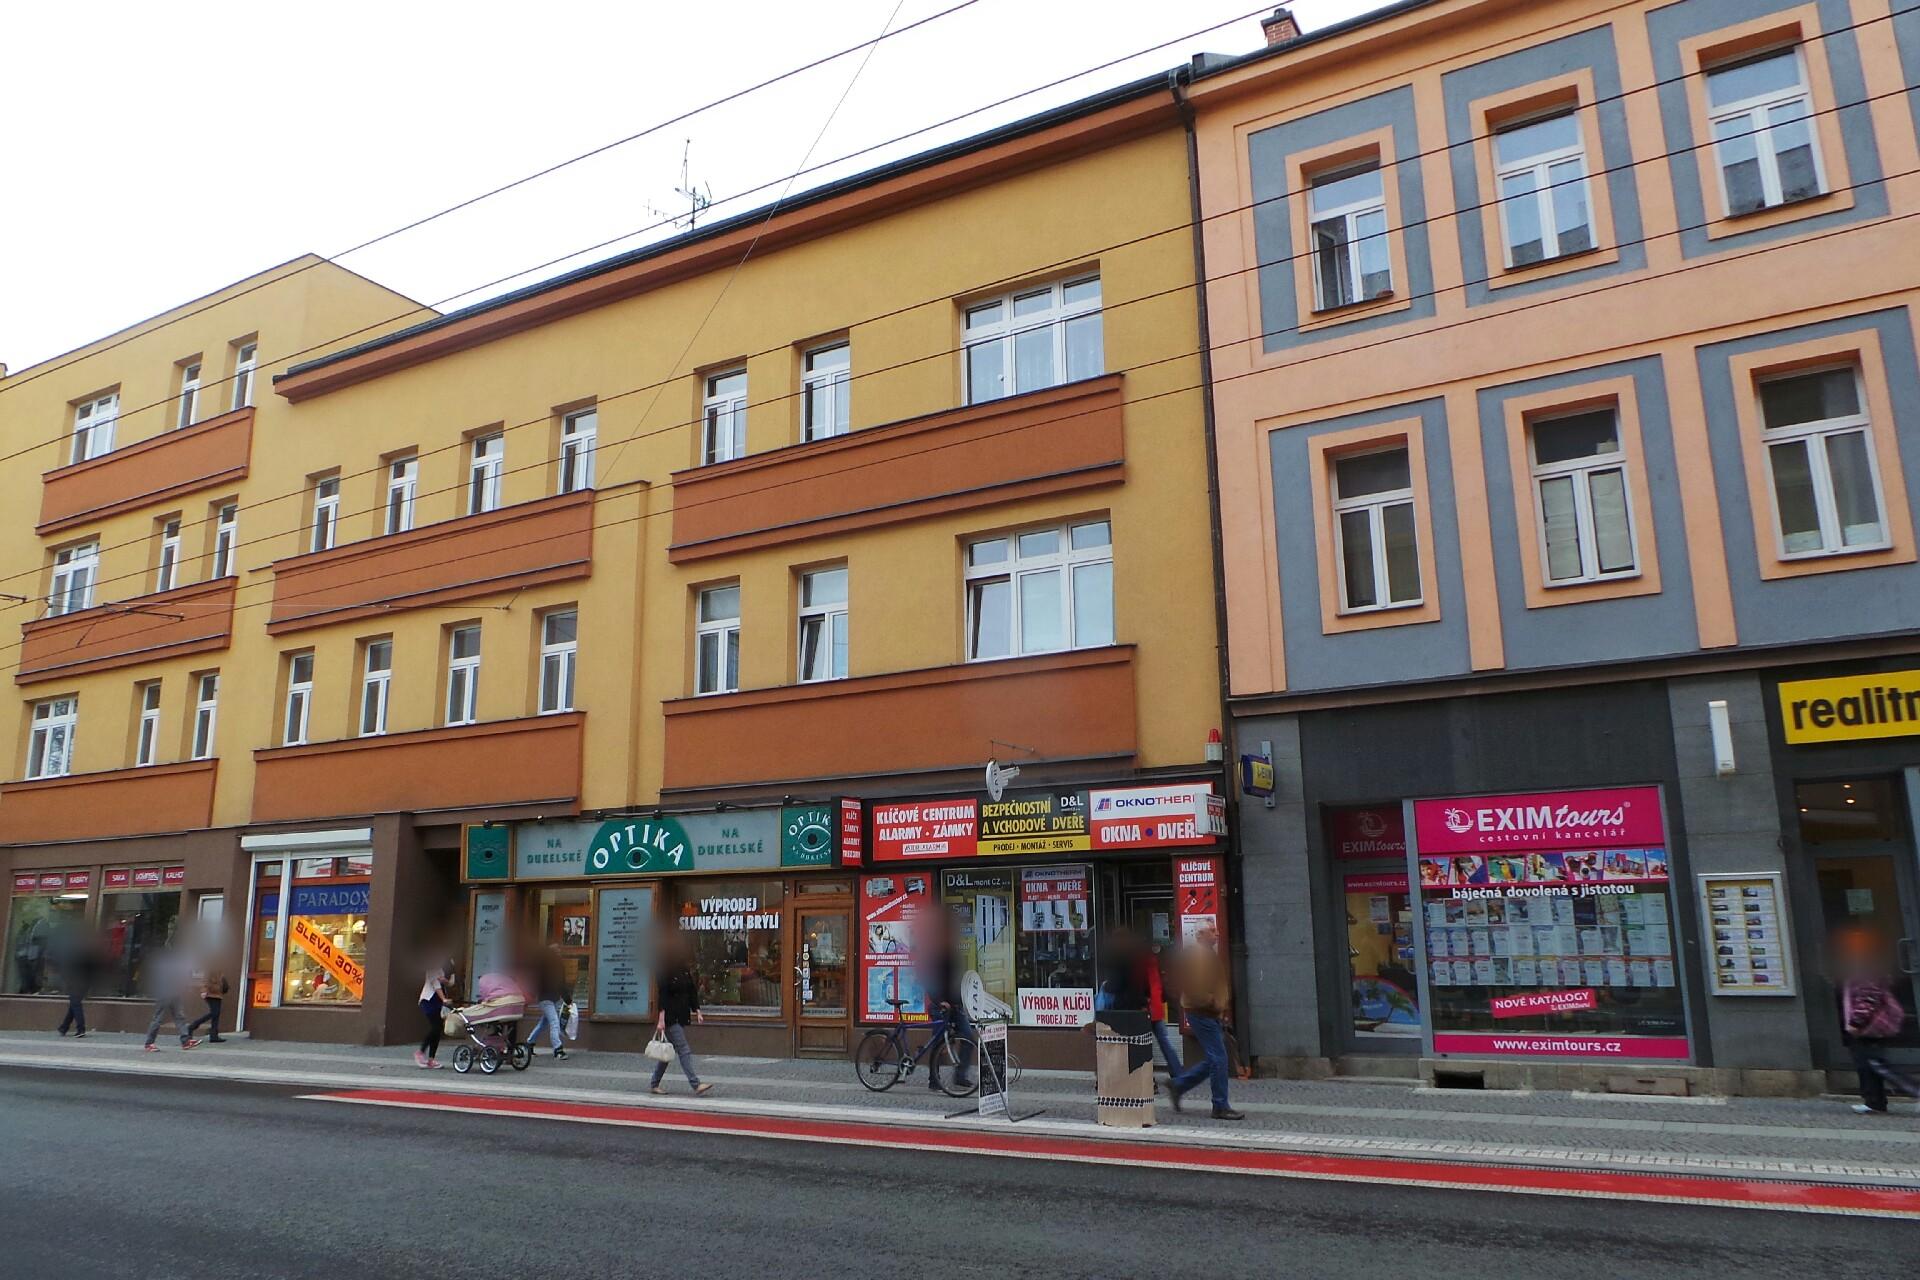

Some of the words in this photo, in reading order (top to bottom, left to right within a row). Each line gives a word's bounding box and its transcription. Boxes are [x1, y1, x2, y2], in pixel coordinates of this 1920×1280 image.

[983, 796, 1051, 818] BEZPEČNOSTNÍ
[1060, 795, 1084, 807] D&L
[1115, 794, 1195, 807] OKNOTHER
[876, 807, 919, 825] KLÍČOVÉ
[922, 805, 975, 822] CENTRUM
[879, 826, 923, 841] ALARMY
[933, 821, 974, 839] ZÁMKY
[982, 821, 990, 835] A
[992, 815, 1046, 834] VCHODOVÉ
[1052, 812, 1085, 830] DVEŘE
[722, 828, 740, 838] NA
[1100, 824, 1142, 843] OKNA
[1479, 832, 1546, 843] cestovní
[1555, 828, 1626, 840] kancelář
[547, 839, 562, 849] NA
[593, 824, 685, 869] OPTIKA
[698, 840, 764, 856] DUKELSKÉ
[993, 843, 1015, 852] PRODEJ
[1020, 841, 1046, 851] MONTÁŽ
[1052, 840, 1074, 849] SERVIS
[527, 852, 583, 864] DUKELSKÉ
[1181, 860, 1211, 872] KLÍČOVÉ
[947, 874, 973, 886] D&L
[973, 879, 991, 887] mont
[991, 878, 1001, 886] CZ
[1179, 873, 1214, 883] CENTRUM
[1025, 882, 1049, 893] OKNA
[1057, 880, 1082, 892] DVEŘE
[1452, 886, 1502, 901] báječná
[1506, 885, 1569, 898] dovolená
[1570, 887, 1577, 896] s
[1579, 883, 1634, 898] jistotou
[298, 890, 369, 907] PARADOX
[700, 896, 757, 913] VÝPRODEJ
[679, 913, 744, 930] SLUNEČNÍCH
[746, 912, 780, 929] BRÝLÍ
[295, 921, 332, 958] SLEVA
[335, 955, 363, 985] 30%
[1021, 992, 1060, 1011] VÝROBA
[1063, 992, 1091, 1011] KLÍČŮ
[1495, 996, 1528, 1009] NOVÉ
[1529, 991, 1589, 1006] KATALOGY
[1036, 1014, 1062, 1025] PRODEJ
[1065, 1014, 1078, 1024] ZDE
[1493, 1039, 1622, 1052] www.eximtours.cz
